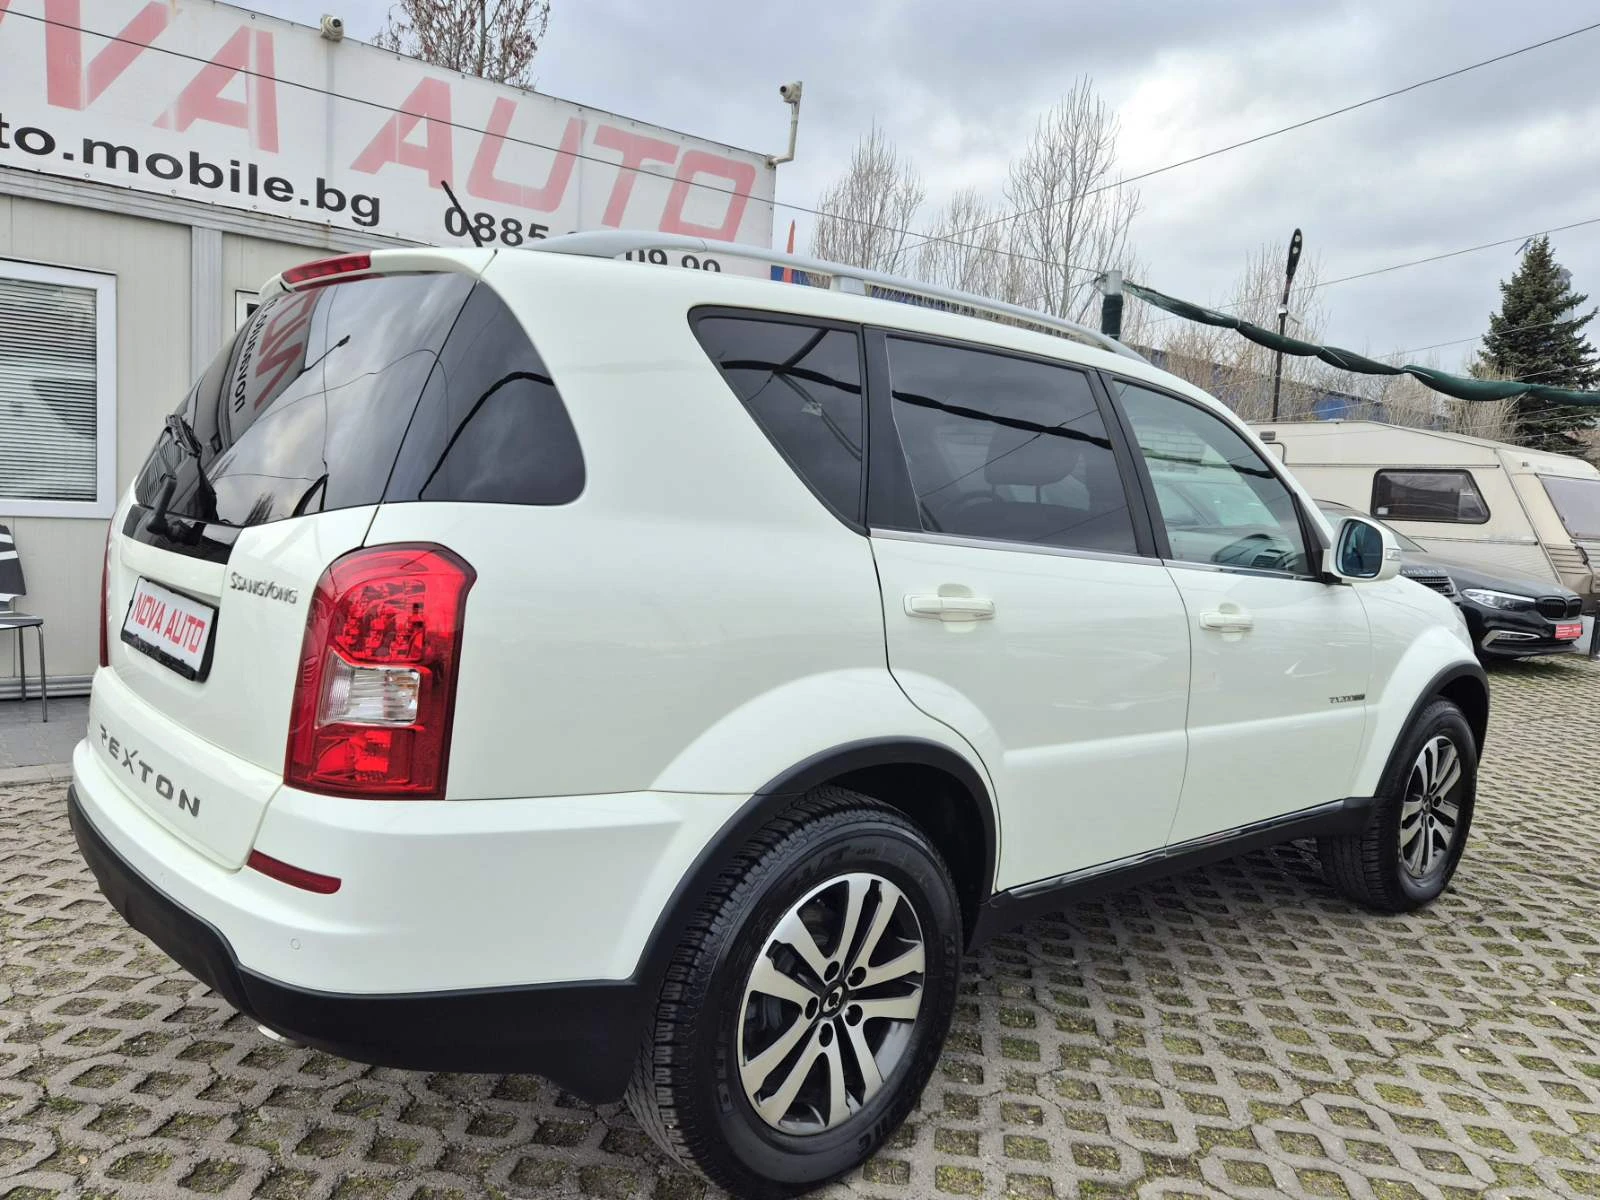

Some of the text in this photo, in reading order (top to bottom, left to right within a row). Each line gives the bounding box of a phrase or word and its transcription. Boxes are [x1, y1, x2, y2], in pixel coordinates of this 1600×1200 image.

[0, 0, 757, 243] VA AUTO
[132, 591, 206, 654] NOVA AUTO
[99, 723, 201, 818] REXTON
